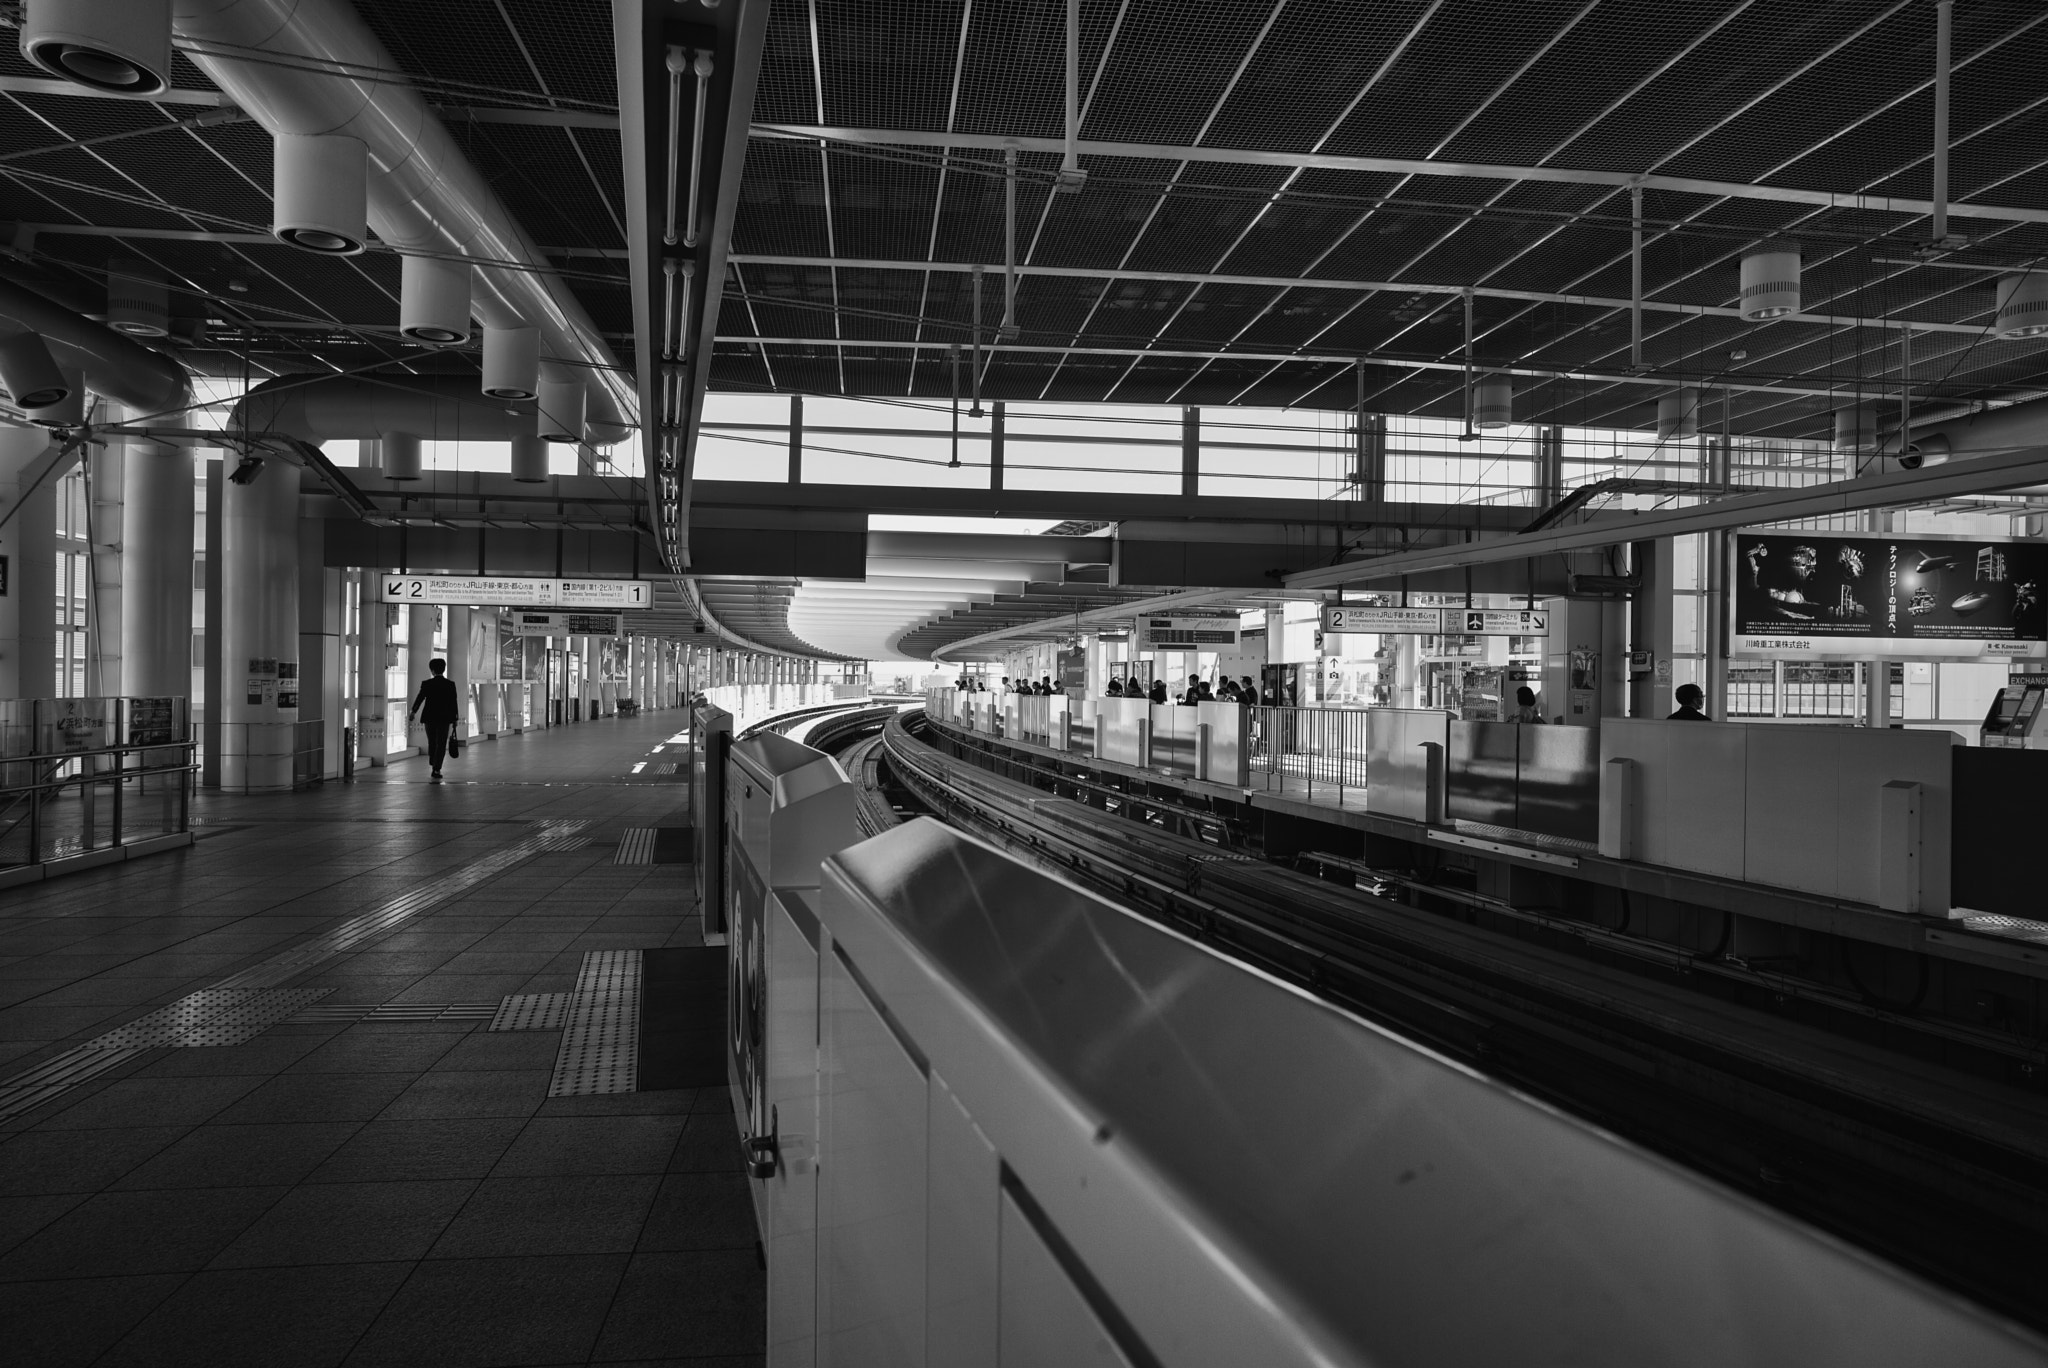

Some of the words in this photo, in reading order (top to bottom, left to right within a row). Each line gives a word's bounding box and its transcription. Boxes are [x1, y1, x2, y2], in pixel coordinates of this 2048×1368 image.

[411, 581, 423, 598] 2
[632, 586, 640, 602] 1
[1888, 545, 1898, 634] テクノロジーの頂点へ。
[1333, 611, 1343, 627] 2
[1447, 611, 1461, 620] 出口
[1745, 639, 1811, 650] 川崎重工業株式会社
[68, 703, 74, 715] 2
[65, 717, 104, 730] 浜松町方面
